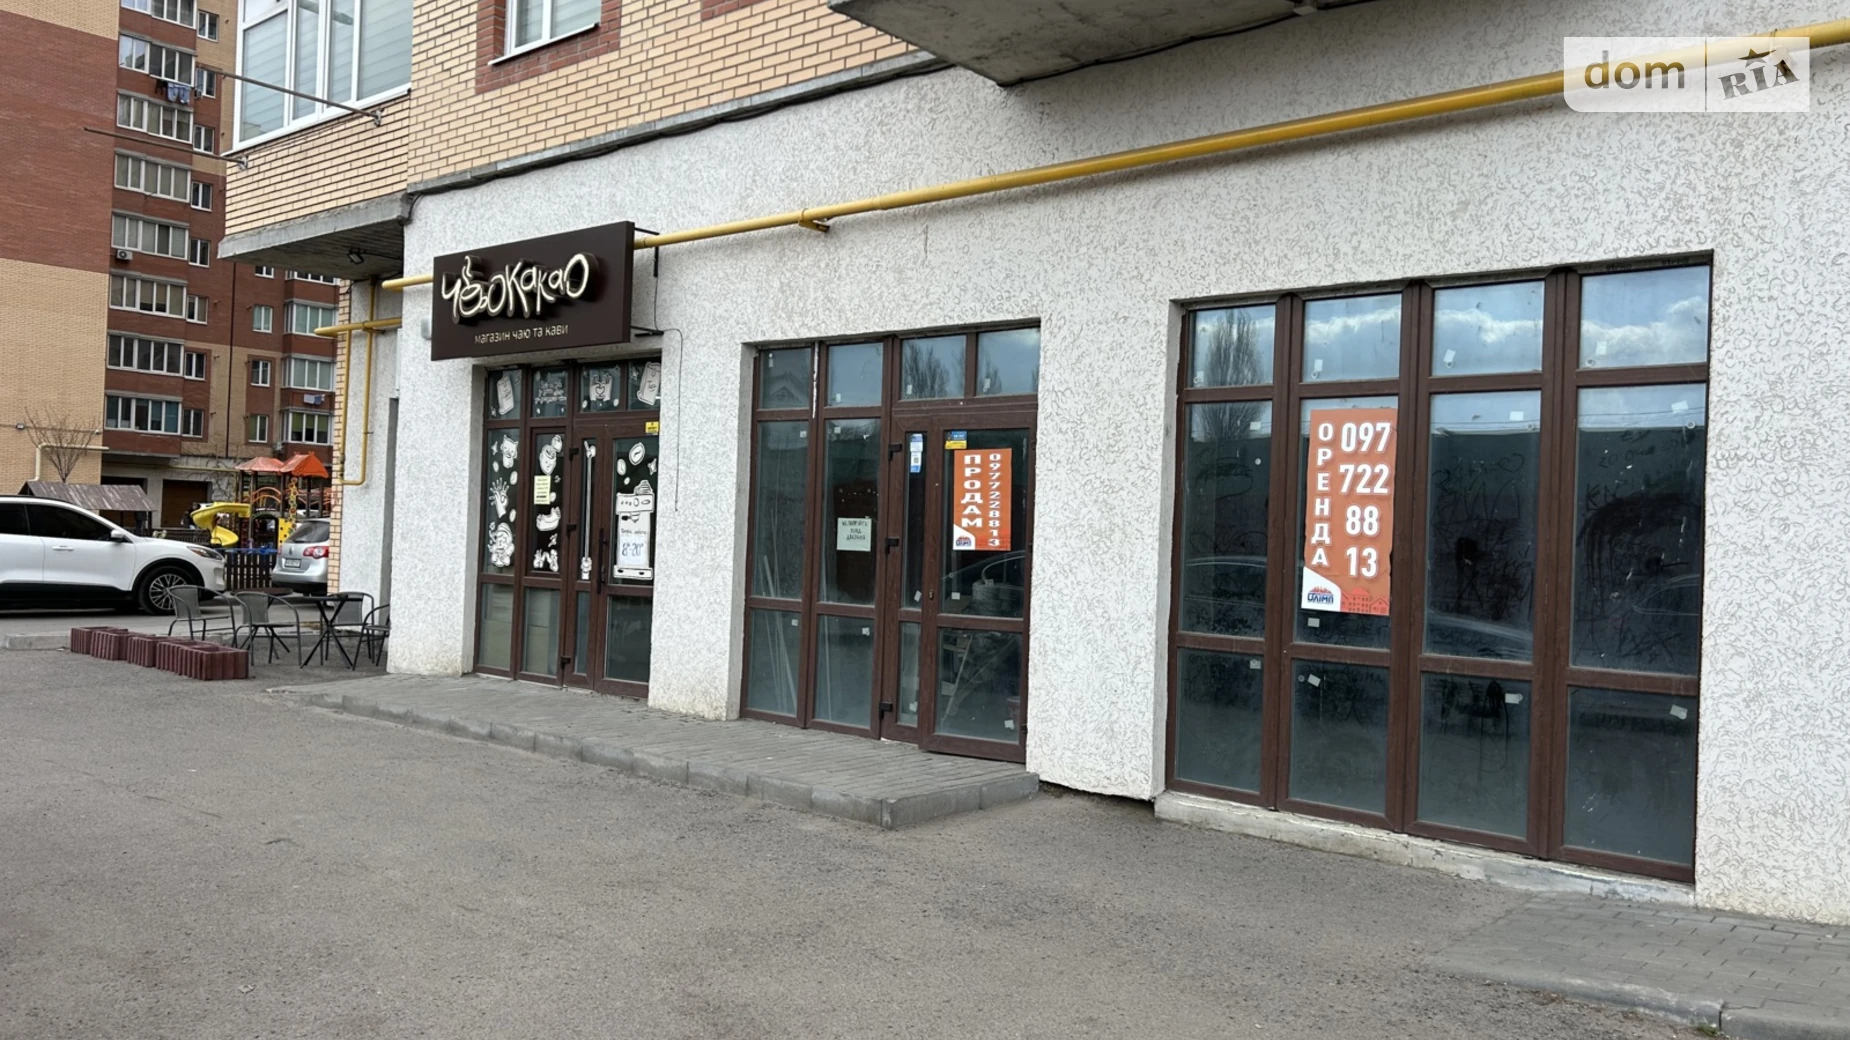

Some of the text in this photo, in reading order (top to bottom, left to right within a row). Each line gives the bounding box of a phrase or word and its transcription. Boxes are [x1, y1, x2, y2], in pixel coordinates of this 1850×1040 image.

[474, 324, 569, 345] магазин чаю та кави
[1340, 421, 1391, 453] 097
[961, 454, 983, 528] ПРОДАМ
[1311, 422, 1334, 567] ОРЕНДА
[1338, 463, 1390, 494] 722
[988, 453, 1002, 547] 0977228813
[1345, 504, 1380, 536] 88
[1345, 546, 1378, 578] 13
